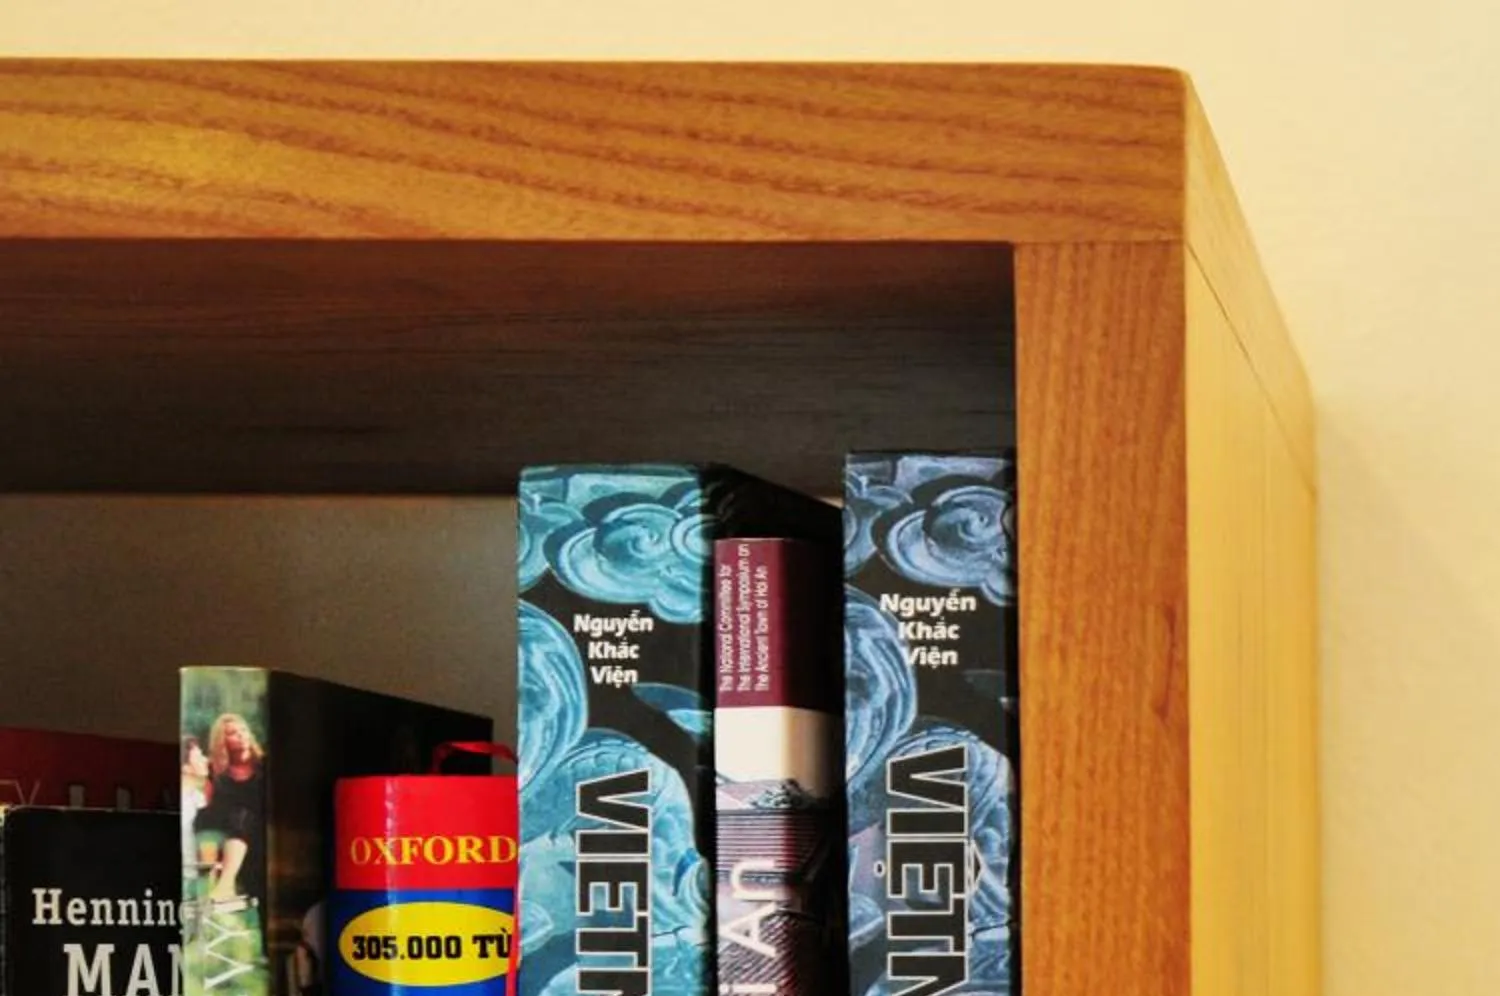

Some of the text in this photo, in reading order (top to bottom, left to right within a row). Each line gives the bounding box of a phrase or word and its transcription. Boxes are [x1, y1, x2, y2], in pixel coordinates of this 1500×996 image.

[351, 835, 517, 866] OXFORD
[720, 858, 778, 956] An
[352, 934, 461, 961] 305.000
